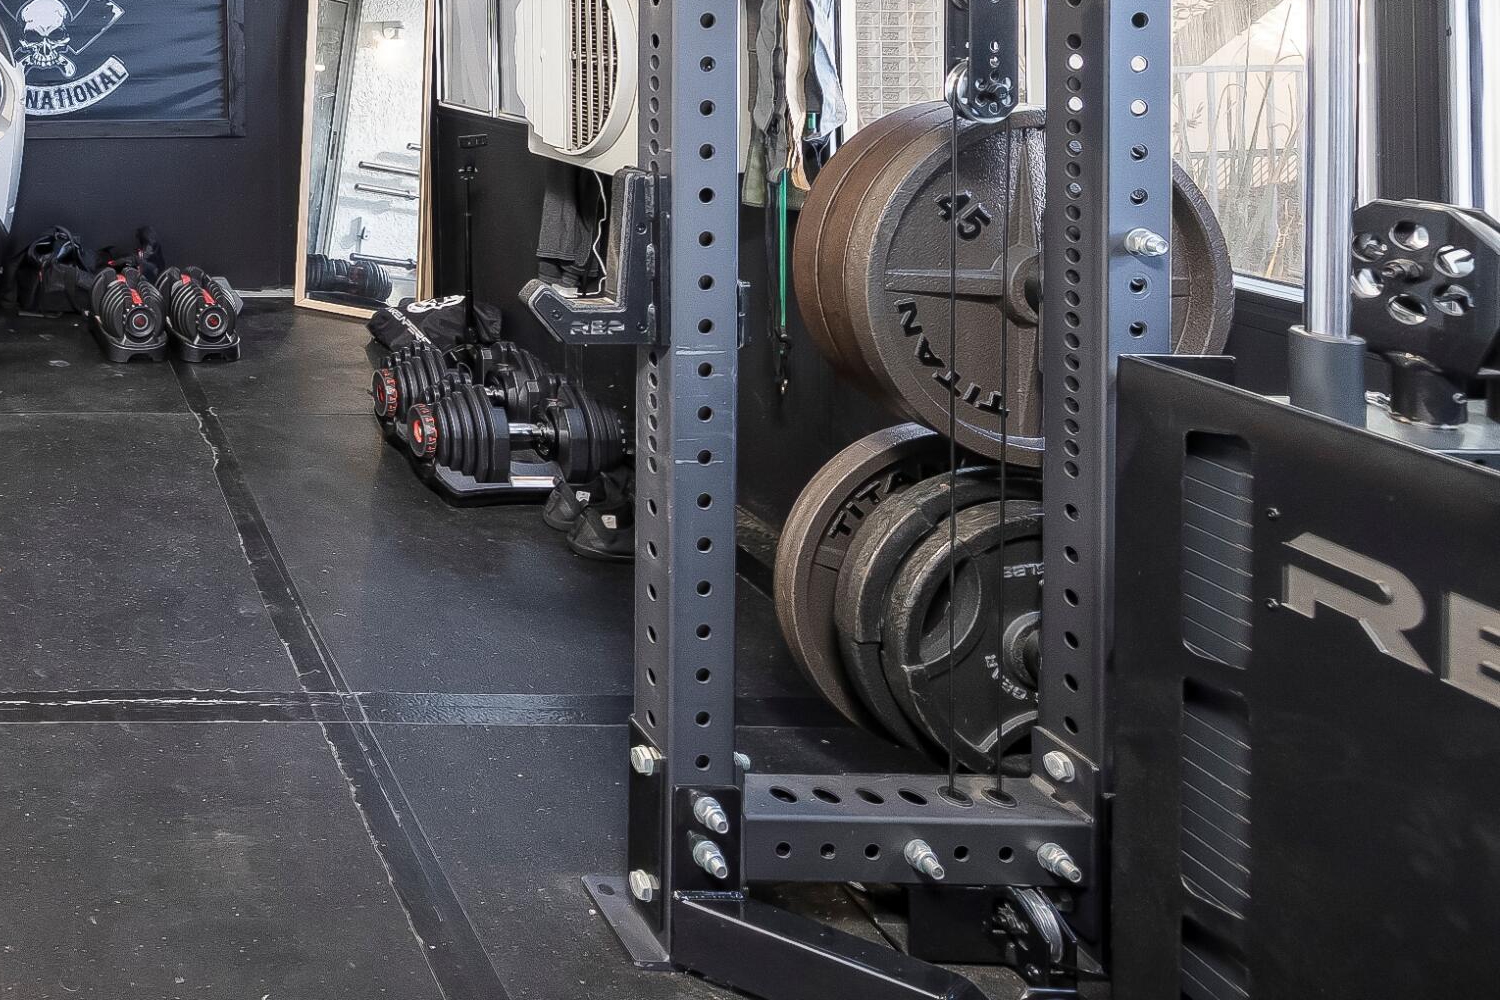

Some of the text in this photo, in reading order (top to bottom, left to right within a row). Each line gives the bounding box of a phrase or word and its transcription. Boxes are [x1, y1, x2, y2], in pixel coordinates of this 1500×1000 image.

[25, 66, 127, 110] NATIONAL
[934, 190, 992, 241] 45
[570, 320, 625, 335] REP
[894, 298, 1010, 418] TITAN
